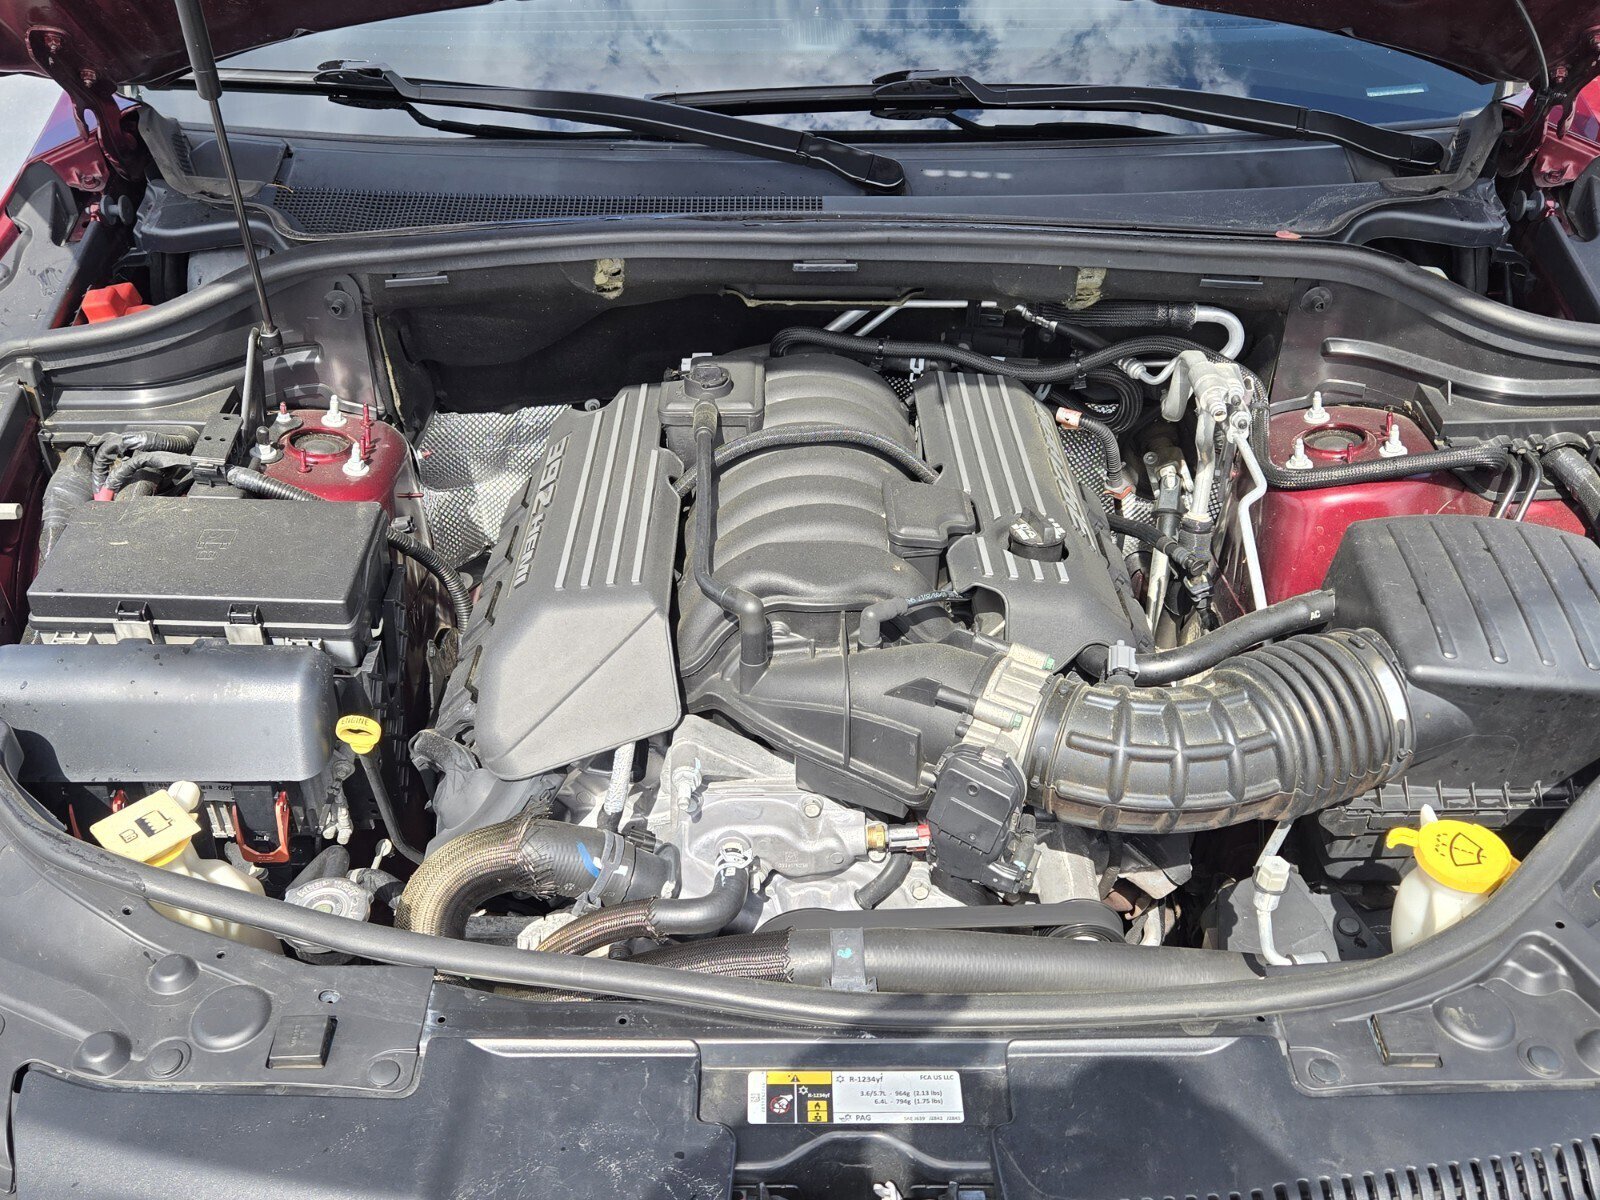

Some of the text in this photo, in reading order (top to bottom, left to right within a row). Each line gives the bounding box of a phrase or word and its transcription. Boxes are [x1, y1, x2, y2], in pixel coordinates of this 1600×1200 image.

[514, 436, 570, 589] 392 HEMI
[341, 717, 369, 726] ENGINE
